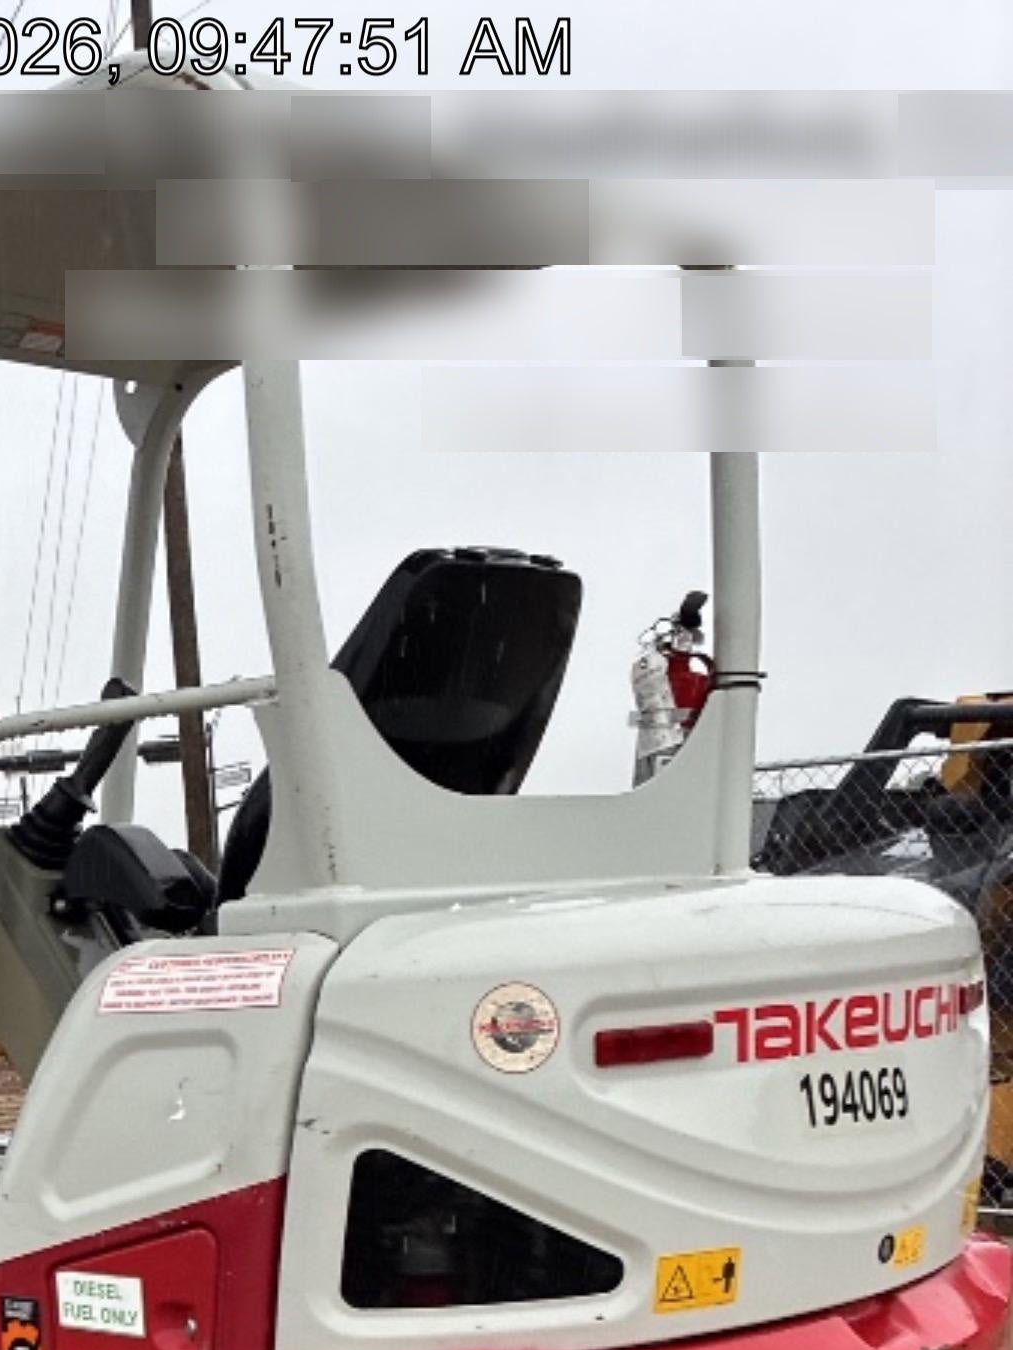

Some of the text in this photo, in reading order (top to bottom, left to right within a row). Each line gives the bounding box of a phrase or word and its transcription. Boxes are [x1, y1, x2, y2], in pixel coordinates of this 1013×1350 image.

[800, 1067, 908, 1128] 194069
[73, 1280, 122, 1300] DIESEL
[63, 1302, 139, 1327] FUEL ONLY
